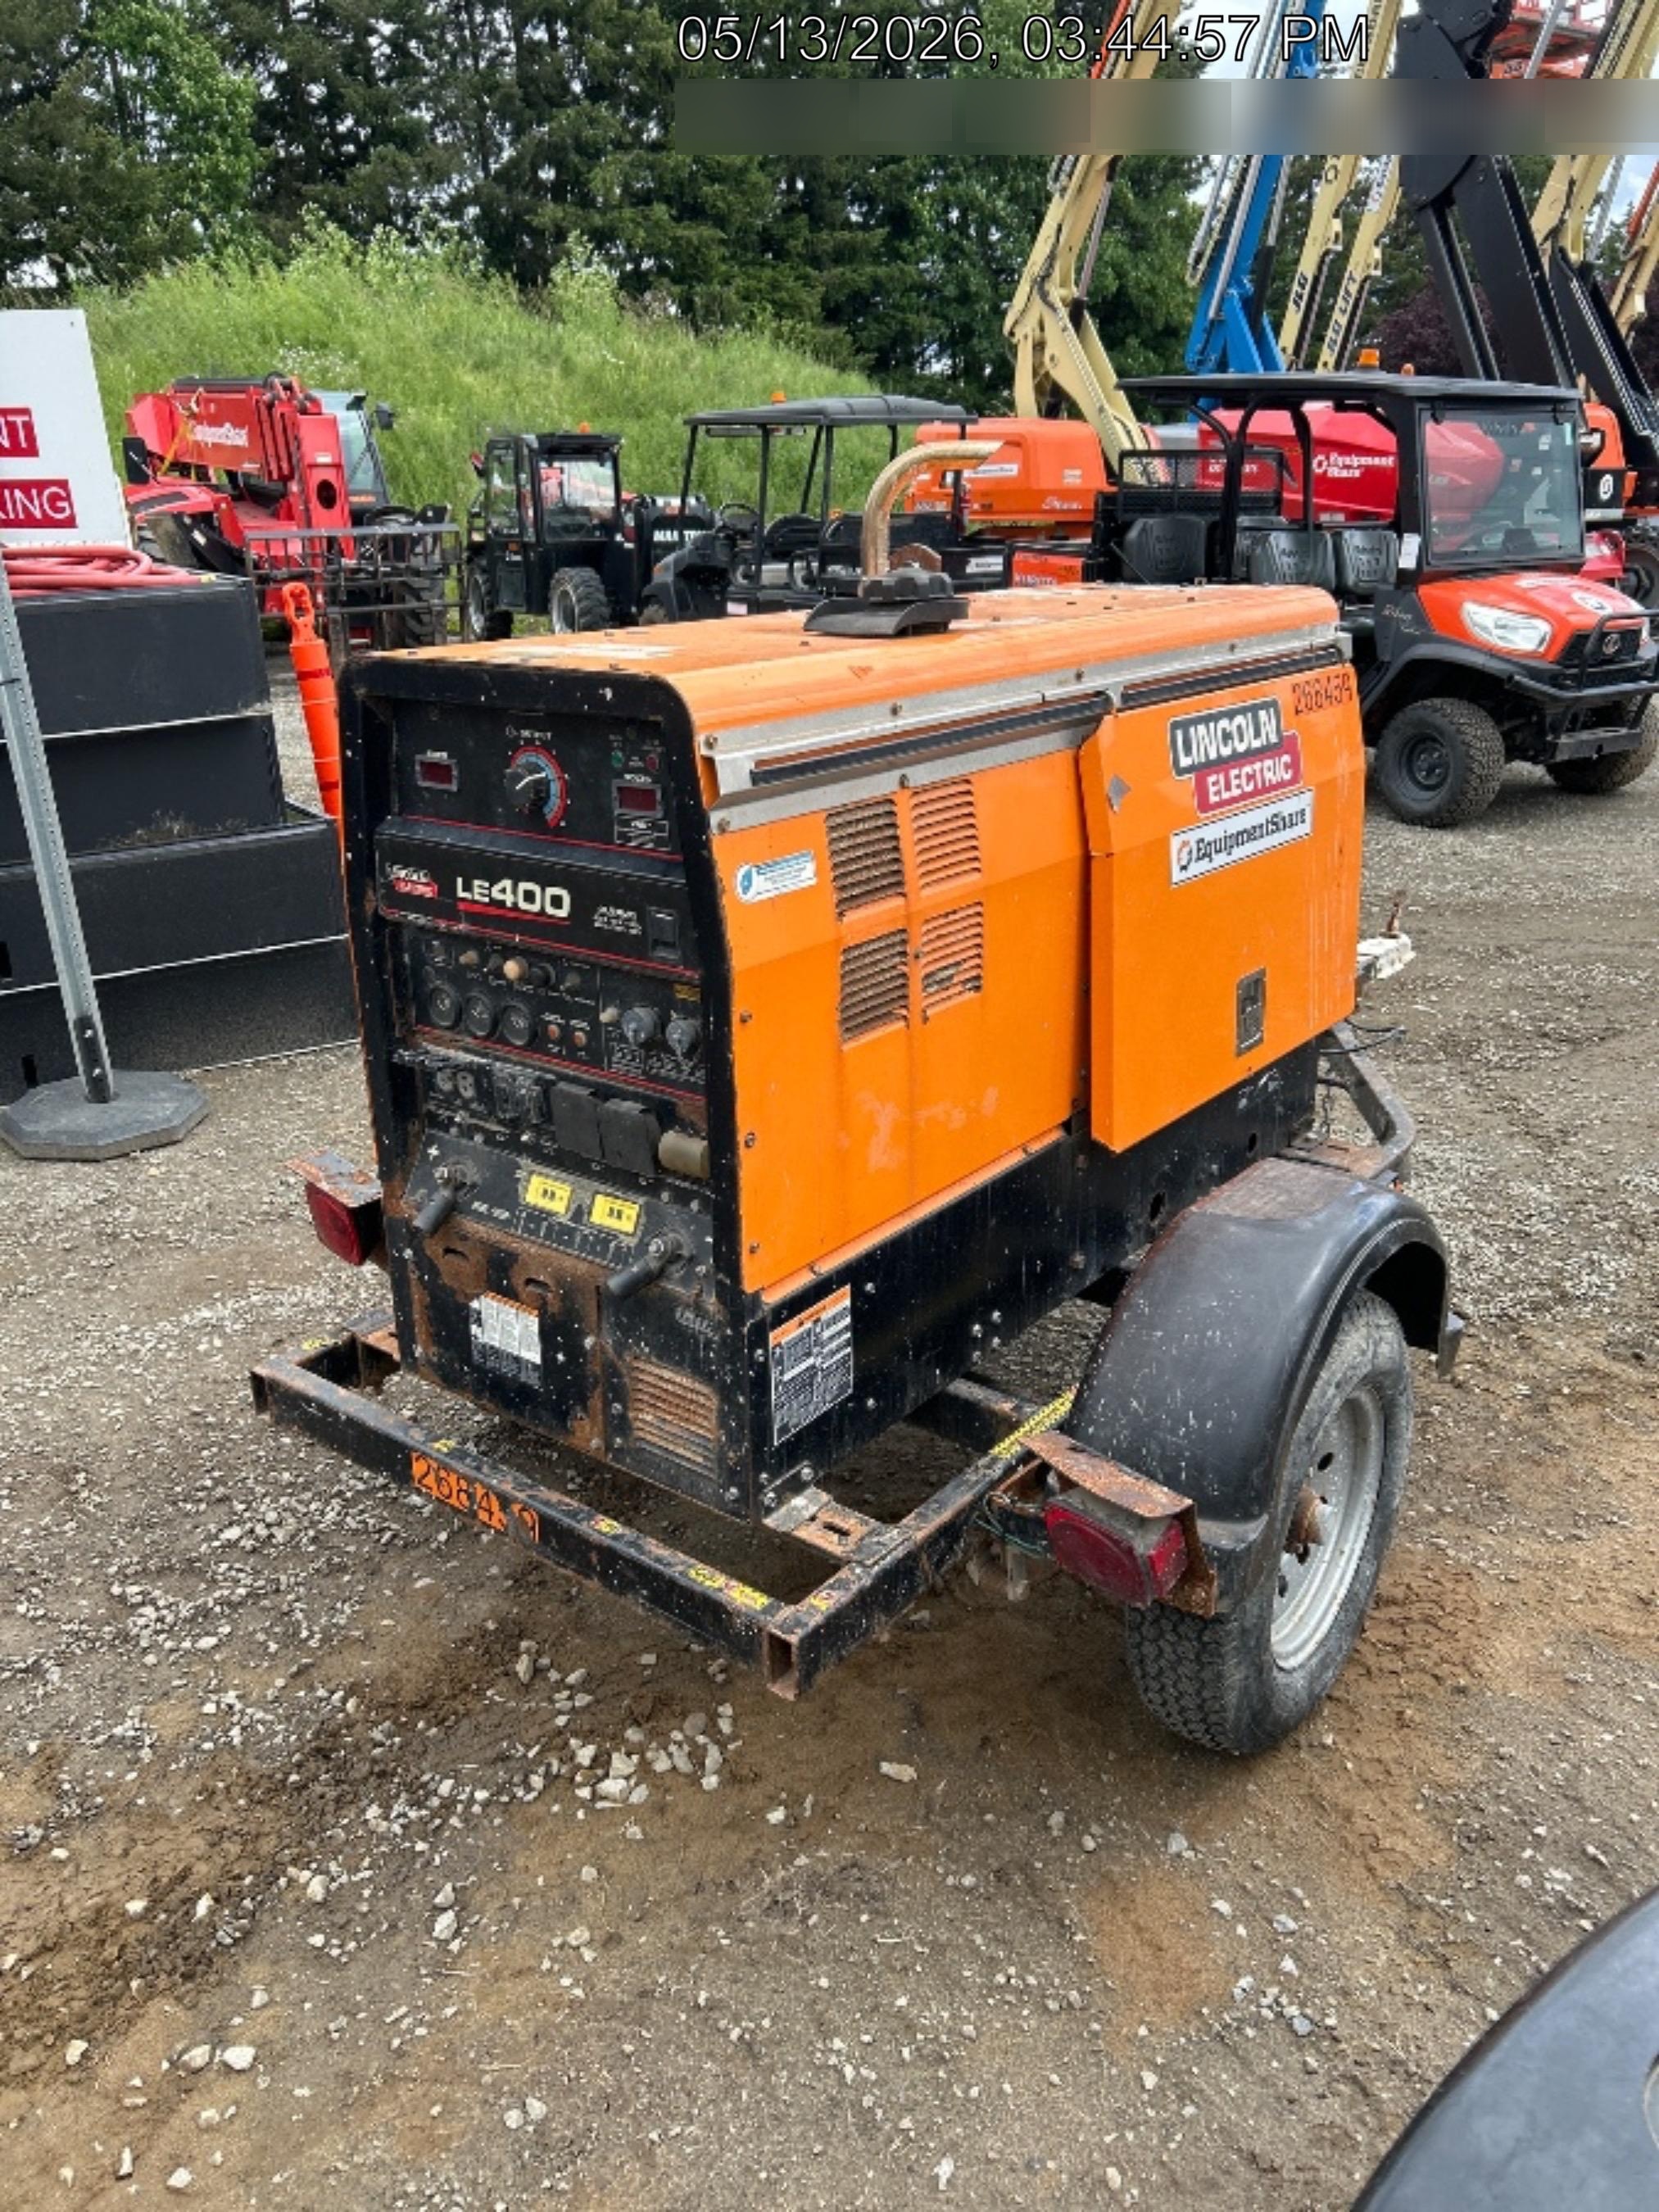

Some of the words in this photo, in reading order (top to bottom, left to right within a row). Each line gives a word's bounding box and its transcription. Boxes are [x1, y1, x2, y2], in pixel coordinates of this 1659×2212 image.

[0, 486, 71, 519] ING
[1176, 707, 1279, 768] LINCOLN
[1207, 754, 1293, 805] ELECTRIC
[1194, 808, 1307, 864] EquipmentShare
[456, 877, 571, 918] LE400
